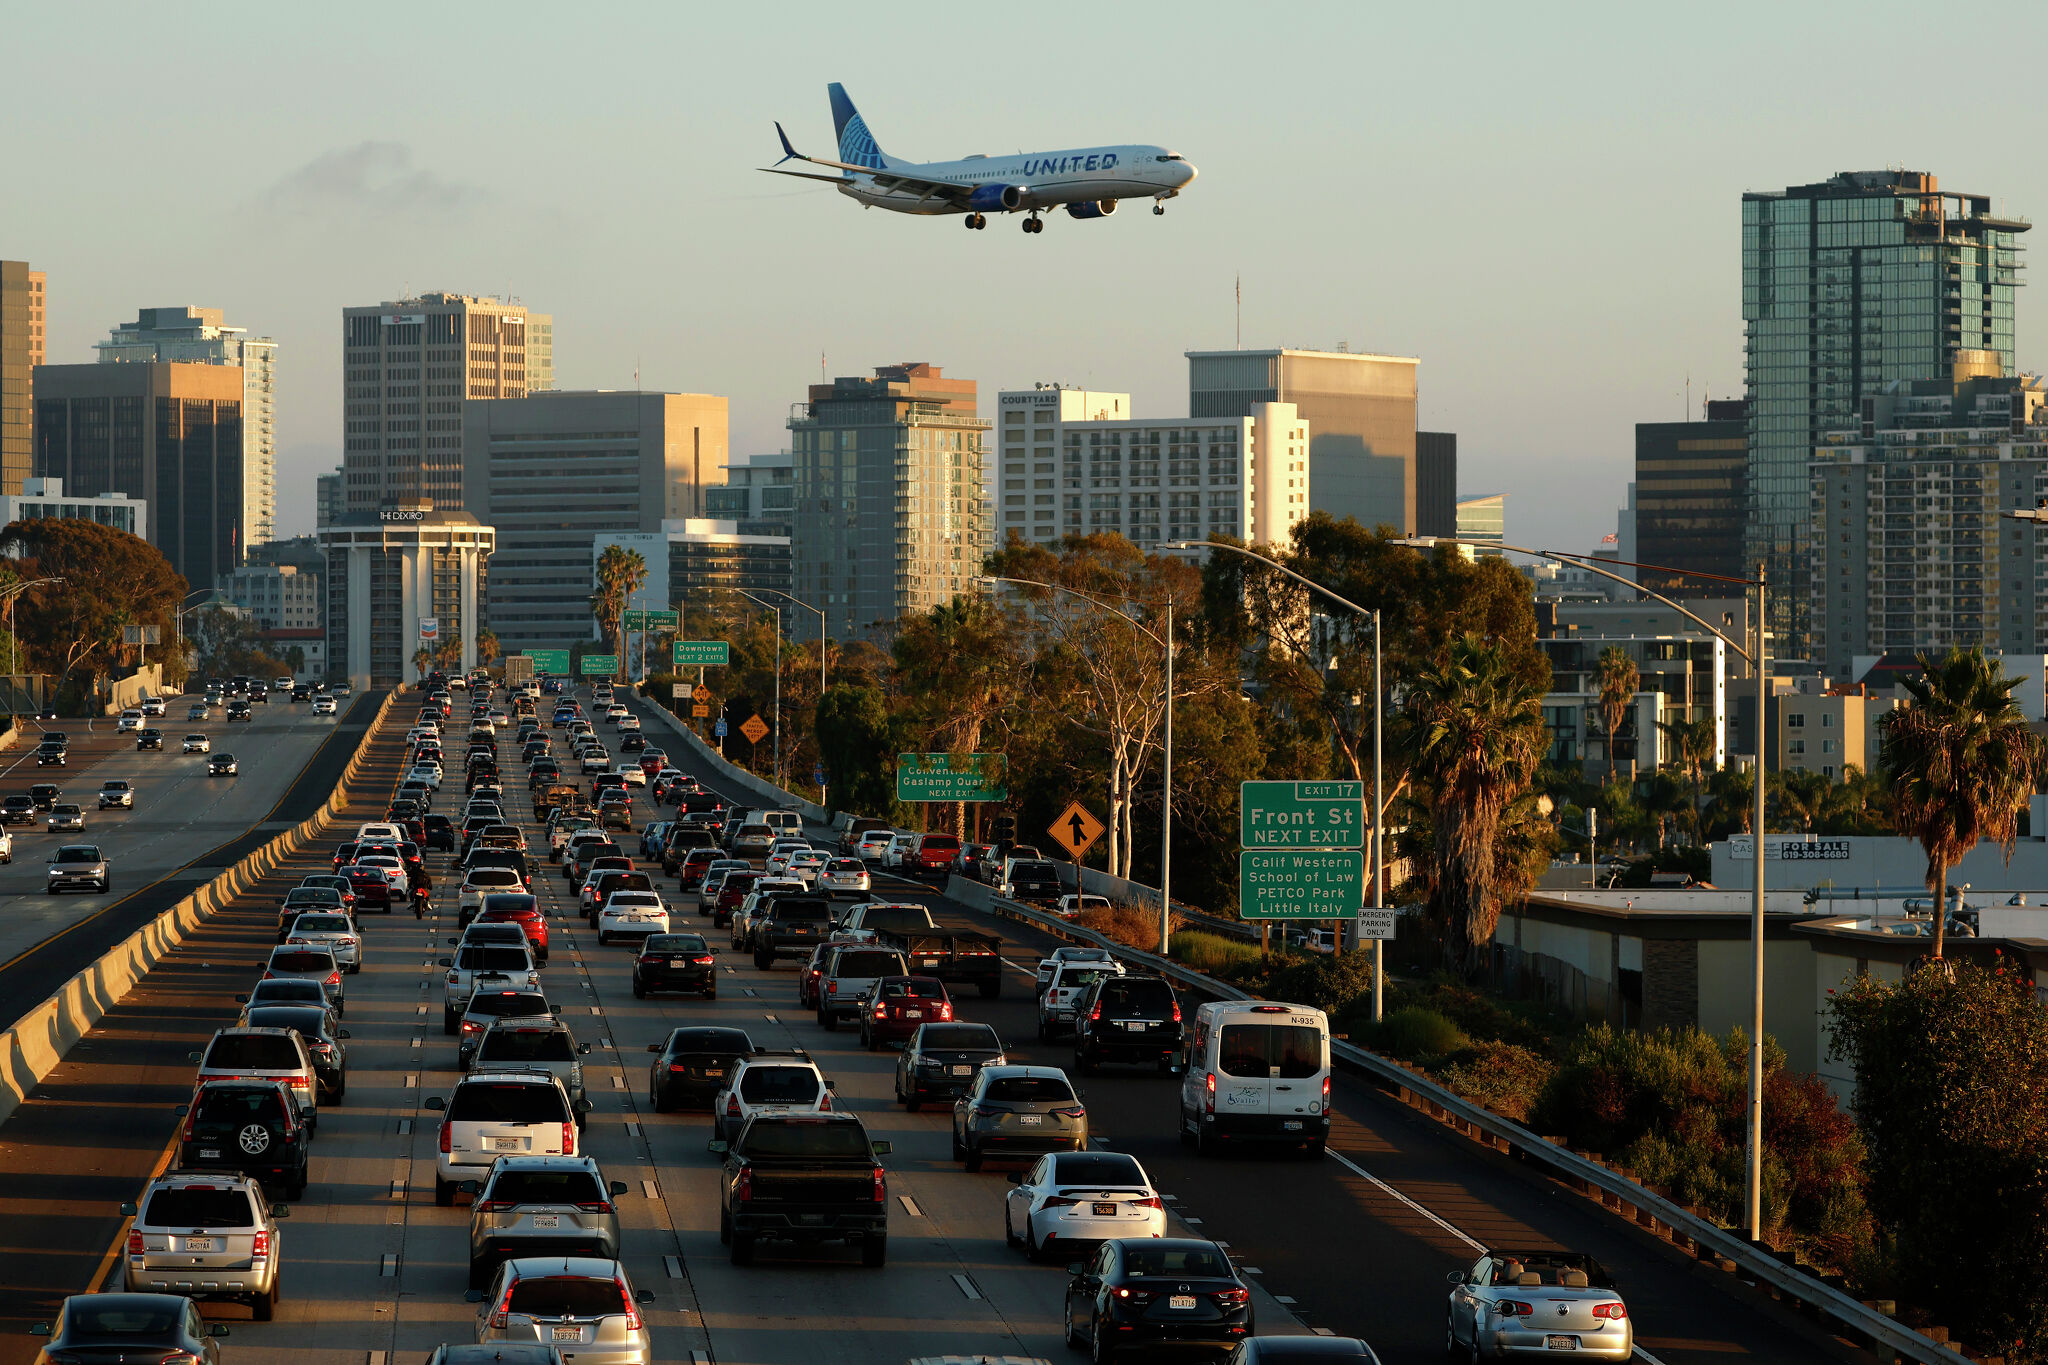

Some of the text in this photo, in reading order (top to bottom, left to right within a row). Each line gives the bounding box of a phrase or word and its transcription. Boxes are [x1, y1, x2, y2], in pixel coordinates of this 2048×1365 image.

[1024, 153, 1117, 177] UNITED
[1001, 395, 1057, 404] COURTYARD
[380, 511, 391, 520] THE
[903, 777, 952, 787] Gaslamp
[1305, 785, 1354, 796] EXIT 17
[1251, 808, 1353, 825] Front St
[1255, 830, 1350, 843] NEXT EXIT
[1783, 843, 1808, 851] FOR
[1814, 843, 1848, 851] SALE
[1783, 851, 1848, 859] 619-308-6680
[1252, 857, 1351, 868] Calif Western
[1249, 872, 1354, 882] School of Law
[1258, 888, 1345, 898] PETCO Park
[1260, 902, 1342, 915] Little Italy
[1358, 911, 1394, 919] EMERGENCY
[1291, 1017, 1314, 1025] N-935
[1235, 1097, 1261, 1105] Valley
